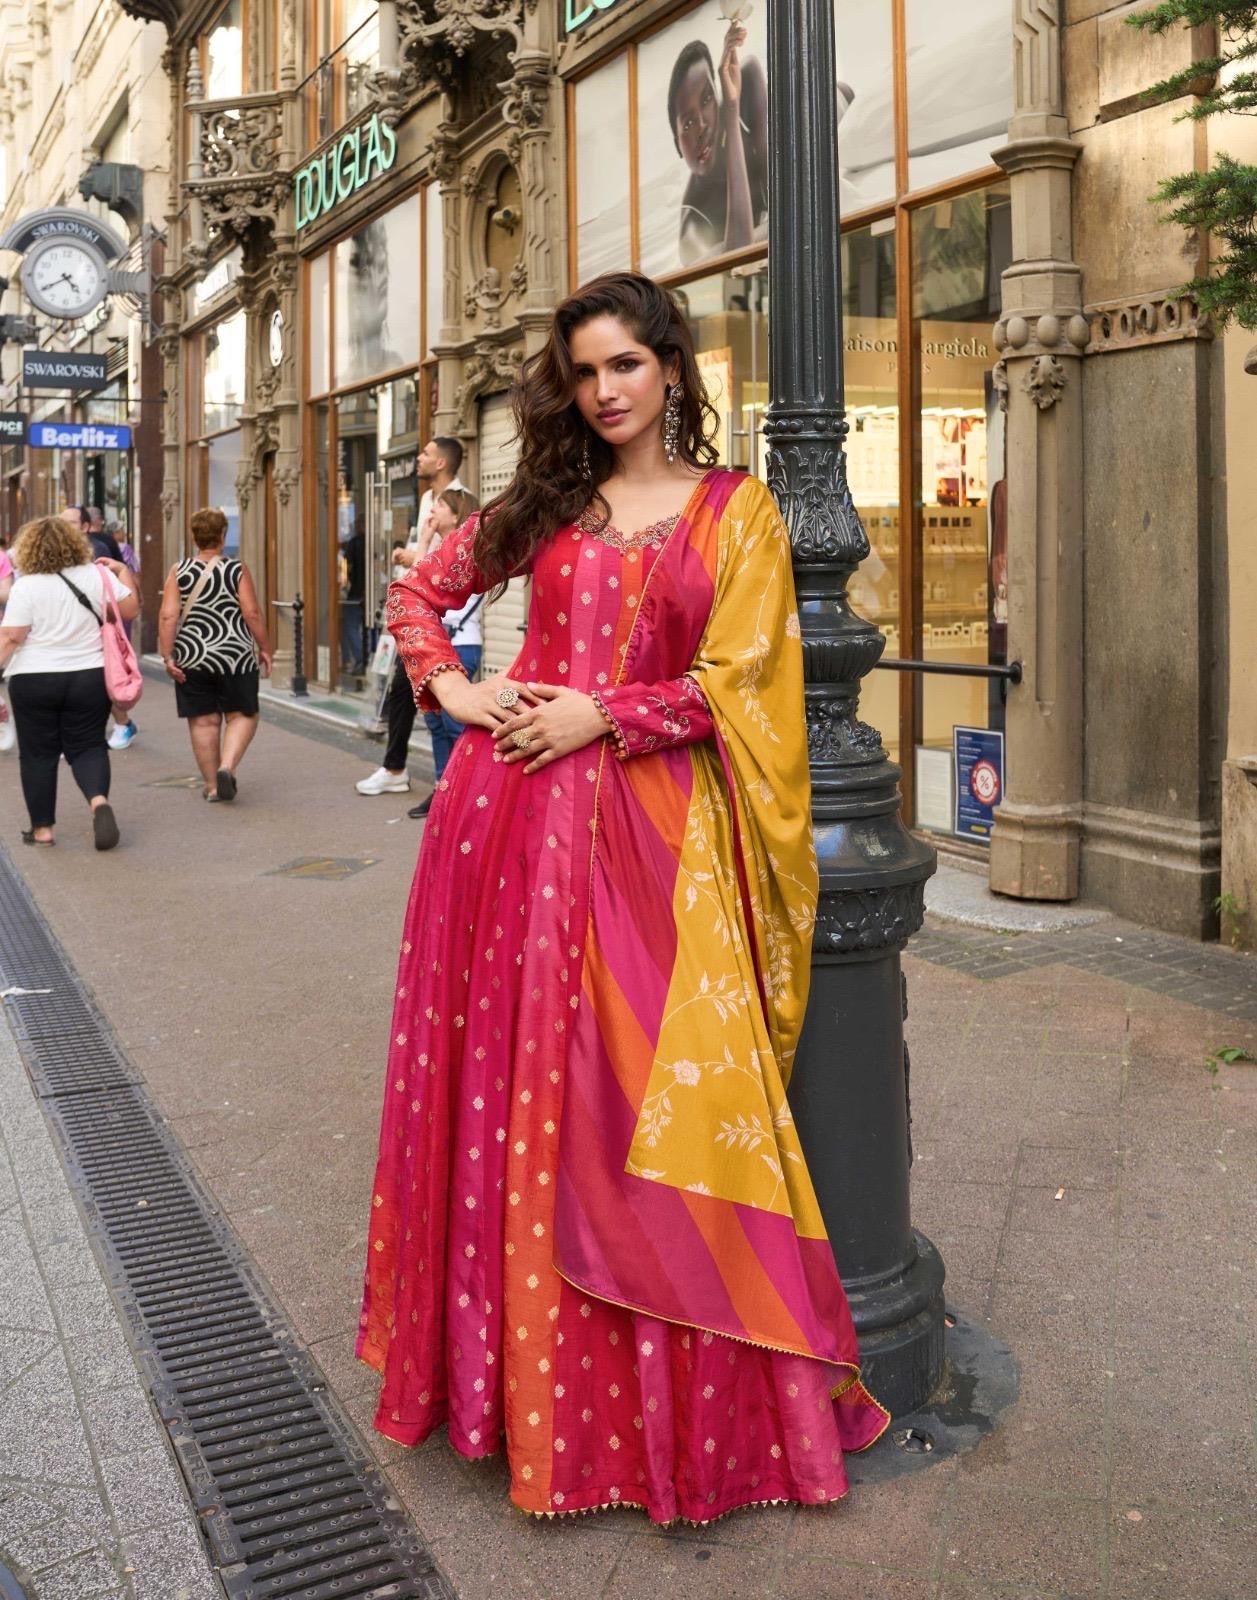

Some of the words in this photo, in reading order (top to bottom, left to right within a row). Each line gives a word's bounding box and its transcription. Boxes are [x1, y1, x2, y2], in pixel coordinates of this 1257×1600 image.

[295, 112, 396, 230] DOUGLAS
[843, 333, 897, 352] aison
[922, 337, 989, 359] argiela
[25, 362, 105, 379] SWAROVSKI
[41, 427, 118, 448] Berlitz
